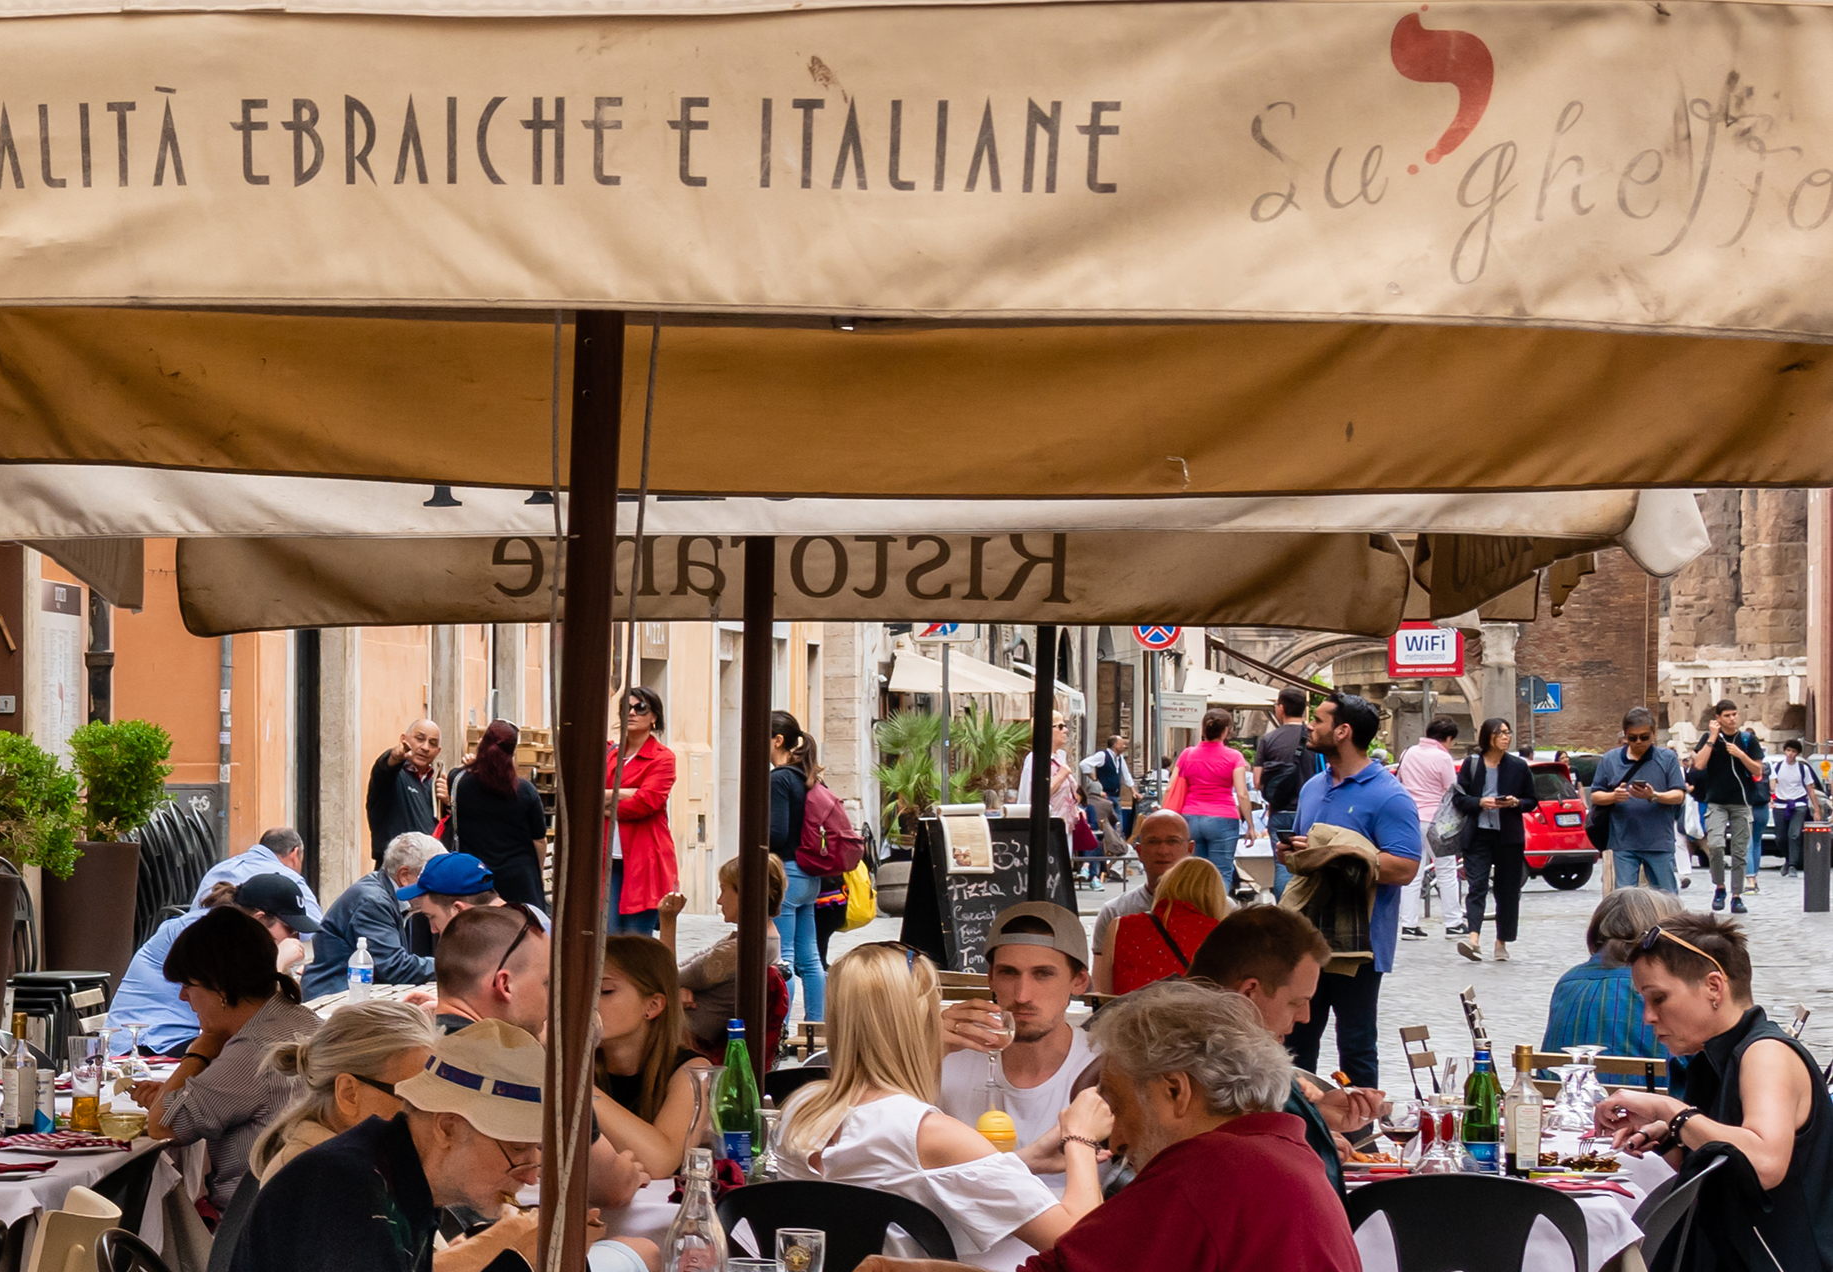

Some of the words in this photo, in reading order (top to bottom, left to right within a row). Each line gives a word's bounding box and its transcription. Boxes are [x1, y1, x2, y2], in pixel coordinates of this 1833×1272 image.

[229, 92, 624, 189] EBRAICHE
[667, 96, 710, 188] E
[759, 95, 1122, 195] ITALIANE
[1405, 634, 1446, 652] WiFi
